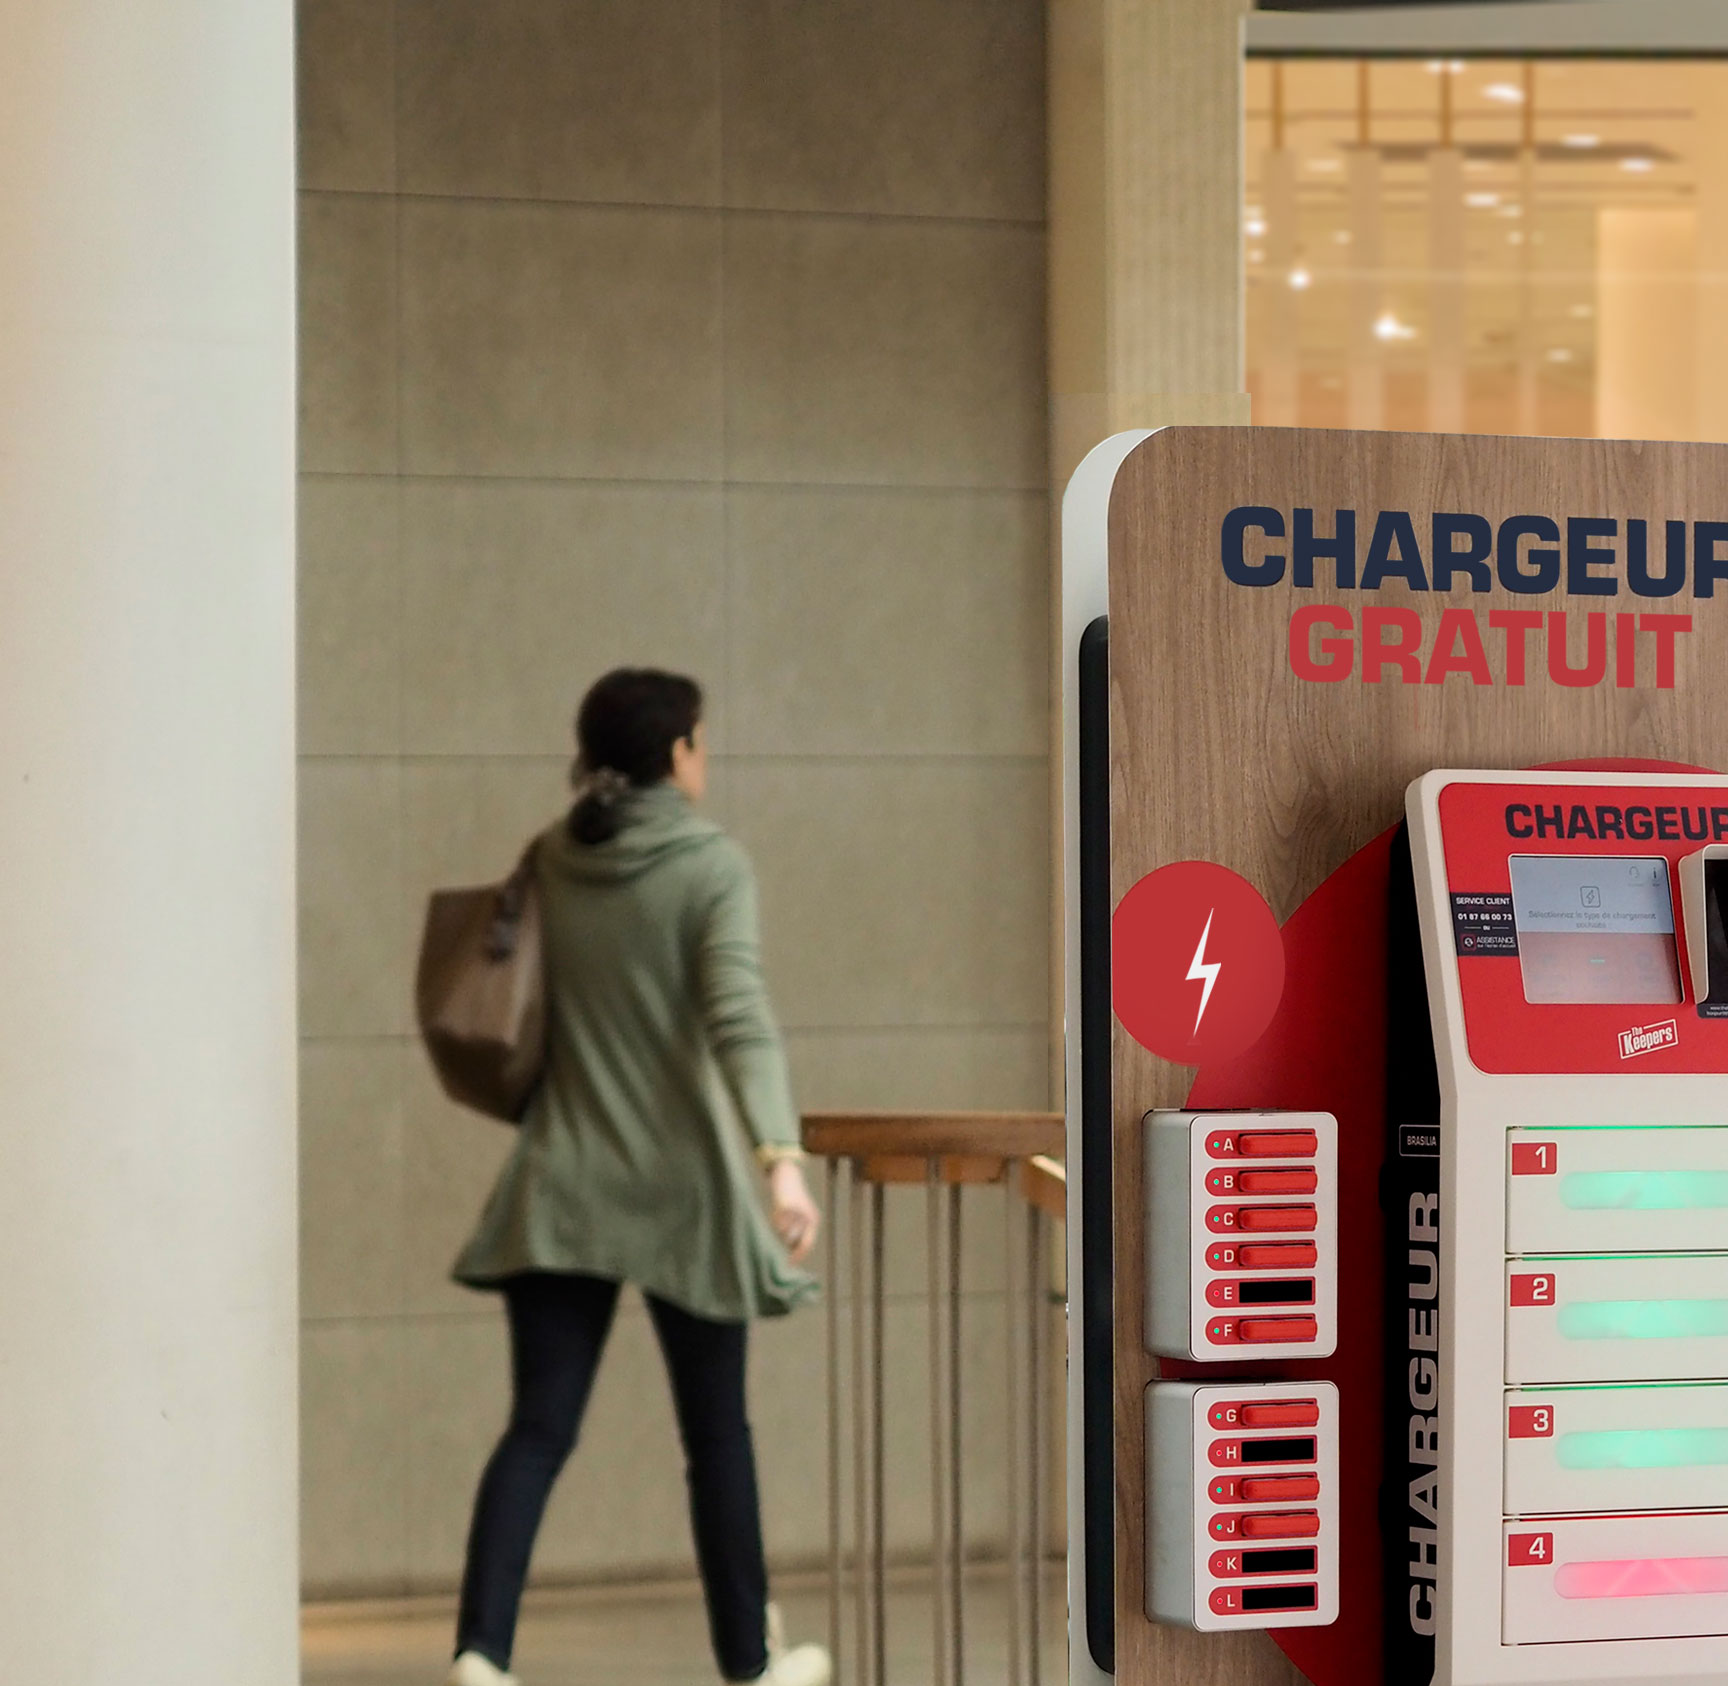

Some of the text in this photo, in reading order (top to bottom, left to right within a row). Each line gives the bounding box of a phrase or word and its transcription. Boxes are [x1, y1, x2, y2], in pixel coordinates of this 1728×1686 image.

[1287, 604, 1692, 689] GRATUIT
[1456, 897, 1510, 905] SERVICE CLIENT
[1491, 913, 1501, 921] 00
[1503, 913, 1512, 921] 73
[1632, 1027, 1643, 1036] The
[1623, 1027, 1673, 1055] Keepers
[1223, 1138, 1234, 1151] A
[1407, 1135, 1437, 1146] BRASILIA
[1534, 1145, 1548, 1169] 1
[1223, 1176, 1234, 1189] B
[1223, 1212, 1234, 1226] C
[1224, 1250, 1235, 1263] D
[1224, 1287, 1233, 1300] E
[1532, 1277, 1549, 1300] 2
[1224, 1324, 1233, 1337] F
[1226, 1409, 1237, 1422] G
[1409, 1191, 1438, 1636] CHARGEUR
[1532, 1409, 1549, 1432] 3
[1226, 1446, 1237, 1459] H
[1230, 1483, 1234, 1496] I
[1226, 1520, 1235, 1533] J
[1527, 1536, 1546, 1559] 4
[1226, 1557, 1237, 1570] K
[1227, 1594, 1235, 1607] L
